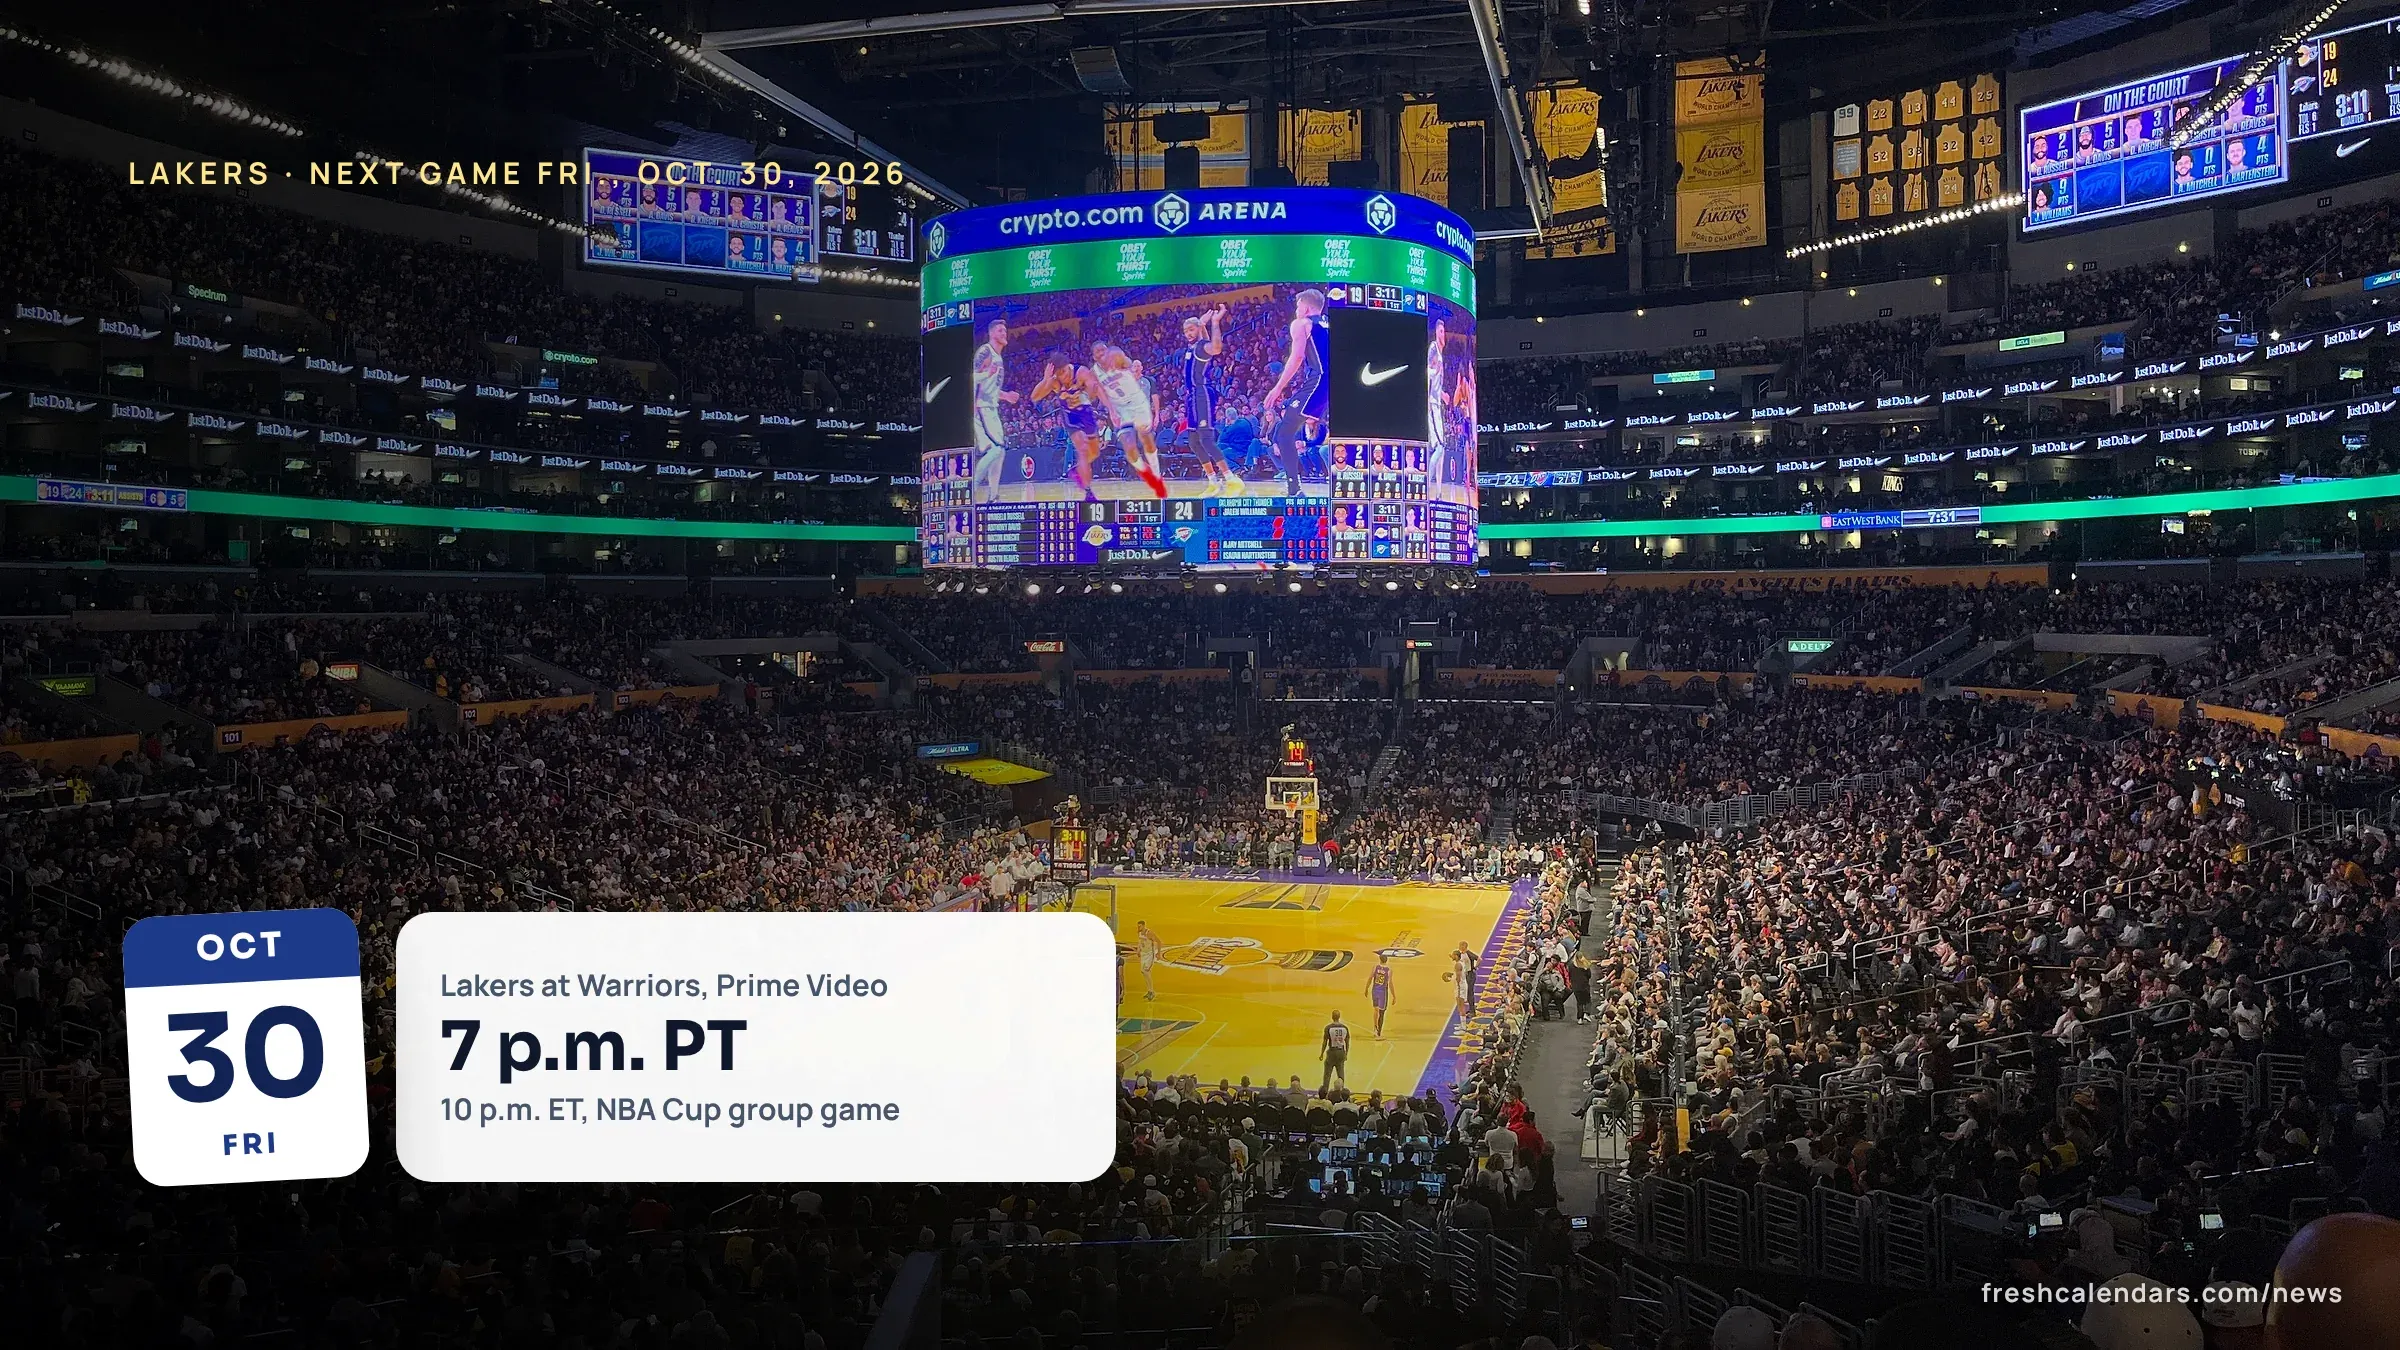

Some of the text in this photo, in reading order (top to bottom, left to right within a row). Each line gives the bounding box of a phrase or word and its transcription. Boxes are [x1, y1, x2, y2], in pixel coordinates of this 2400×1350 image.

[2323, 41, 2337, 60] 19
[2323, 68, 2338, 88] 24
[1977, 90, 1993, 102] 25
[2104, 75, 2190, 113] ON THE COURT
[2256, 85, 2266, 103] 3
[1907, 102, 1922, 114] 13
[1941, 96, 1956, 108] 44
[2336, 89, 2370, 118] 3:11
[1838, 107, 1854, 119] 99
[1872, 108, 1887, 119] 22
[2254, 104, 2268, 115] PTS
[2153, 110, 2162, 127] 3
[2104, 121, 2112, 138] 5
[1943, 140, 1958, 152] 32
[1978, 134, 1993, 145] 42
[2058, 132, 2067, 149] 2
[2103, 138, 2115, 149] PTS
[2257, 136, 2267, 153] 4
[1696, 145, 1745, 164] LAKERS
[1873, 151, 1888, 163] 52
[2057, 149, 2068, 161] PTS
[2093, 152, 2112, 164] DAVIS
[2205, 147, 2213, 164] 0
[2059, 178, 2067, 195] 9
[2057, 194, 2069, 206] PTS
[1000, 201, 1287, 236] crypto.com ARENA
[1695, 207, 1749, 227] LAKERS
[2042, 206, 2072, 221] WILLIAMS
[854, 228, 878, 248] 3:11
[1691, 226, 1752, 243] WORLD CHAMPIONS
[1120, 242, 1147, 254] OBEY
[1220, 239, 1248, 250] OBEY
[1324, 239, 1351, 250] OBEY
[1122, 271, 1146, 282] Sprite
[1222, 268, 1248, 279] Sprite
[1326, 268, 1350, 278] Sprite
[188, 284, 227, 303] Spectrum
[1350, 286, 1363, 303] 19
[1375, 287, 1396, 300] 3:11
[1416, 293, 1425, 309] 24
[959, 303, 970, 318] 24
[2134, 367, 2148, 380] Just
[2149, 364, 2161, 375] Do
[1877, 398, 1891, 409] Just
[1891, 396, 1905, 406] Do
[1356, 445, 1363, 459] 2
[2031, 443, 2047, 455] Just
[2047, 442, 2060, 453] Do
[1504, 475, 1519, 485] 24
[1880, 475, 1905, 492] KINGS
[47, 486, 59, 498] 19
[69, 487, 82, 499] 24
[149, 494, 156, 504] 6
[170, 494, 177, 505] 5
[1090, 501, 1193, 521] 19 3:11 24
[1356, 505, 1363, 519] 2
[1379, 505, 1396, 514] 3:11
[1928, 511, 1957, 523] 7:31
[1107, 549, 1126, 562] Just
[1126, 549, 1140, 560] Do
[464, 709, 477, 719] 102
[224, 731, 240, 742] 101
[950, 745, 969, 753] ULTRA
